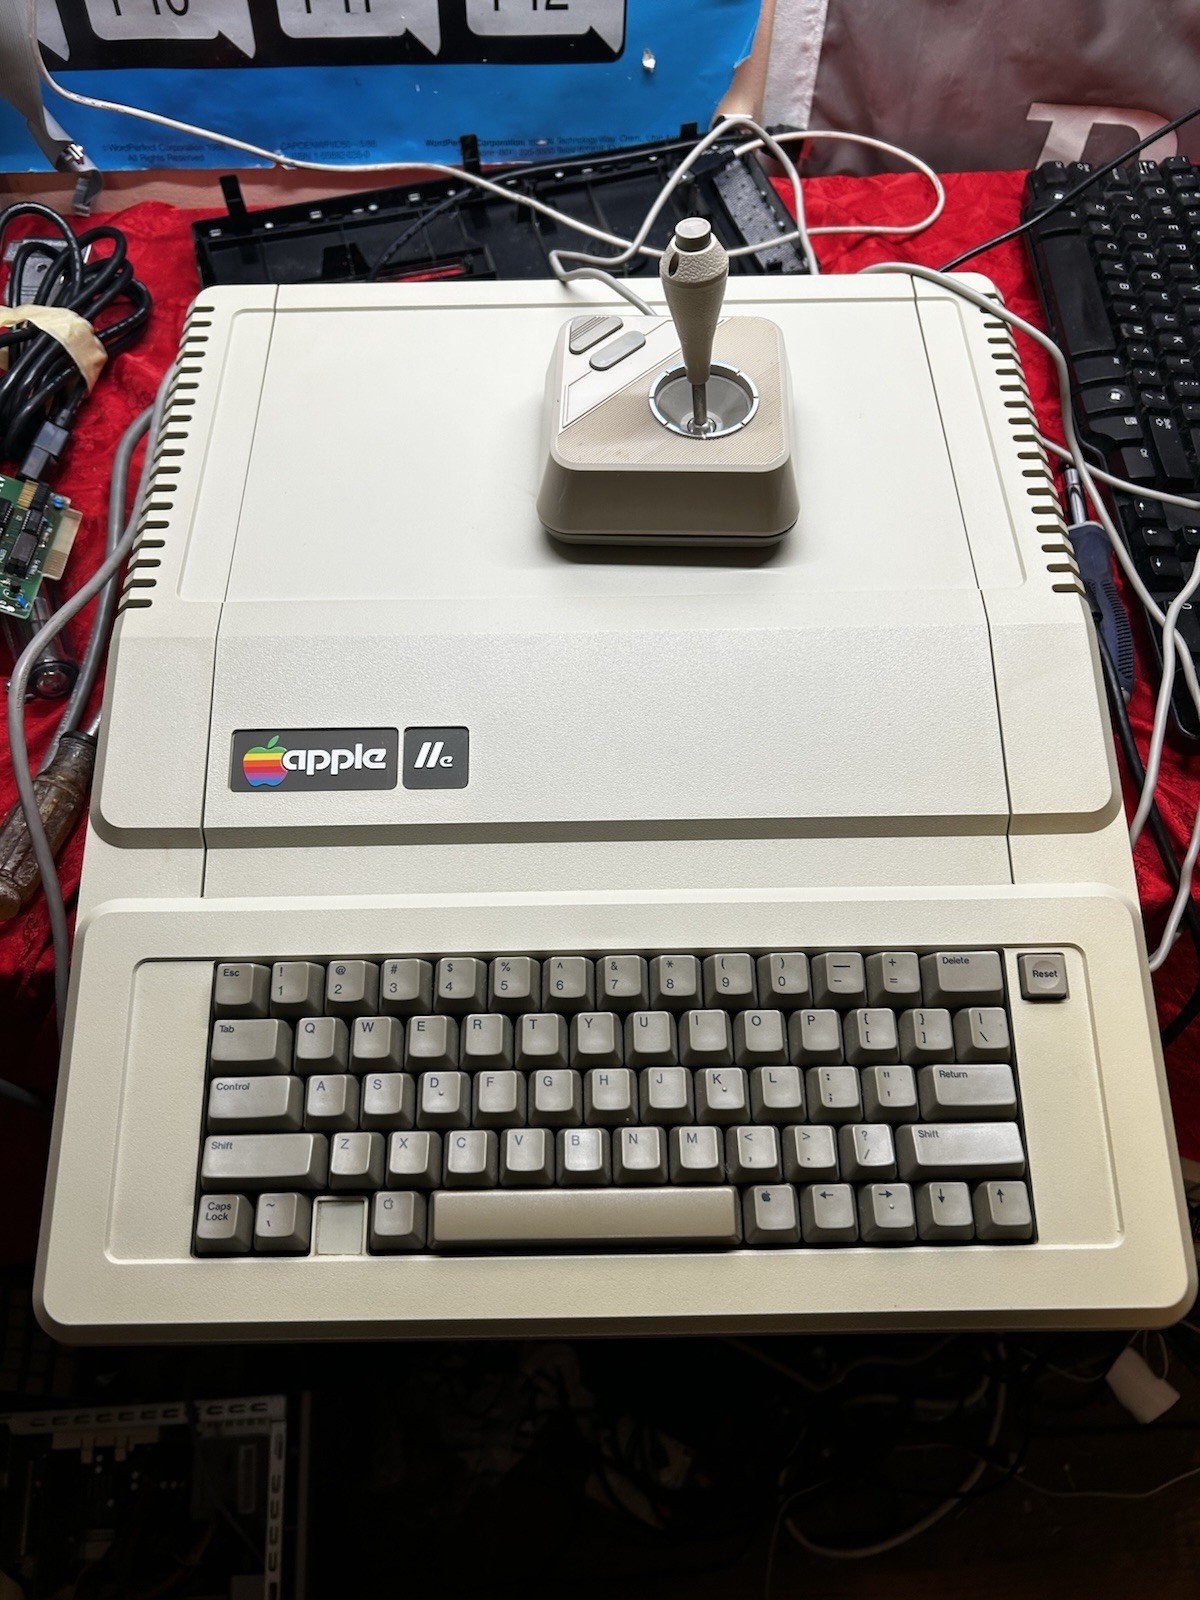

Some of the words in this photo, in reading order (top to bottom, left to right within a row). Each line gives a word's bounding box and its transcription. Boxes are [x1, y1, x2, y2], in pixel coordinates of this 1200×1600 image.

[1137, 232, 1148, 240] D
[1114, 263, 1124, 271] V
[1151, 272, 1161, 280] G
[1173, 336, 1183, 344] K
[282, 743, 387, 776] apple
[1033, 970, 1058, 978] Reset
[445, 981, 453, 992] 4
[500, 979, 509, 991] 5
[555, 979, 564, 991] 6
[611, 978, 619, 990] 7
[666, 978, 675, 990] 8
[721, 976, 730, 988] 9
[777, 975, 787, 987] 0
[333, 983, 343, 995] 2
[389, 982, 398, 994] 3
[416, 1020, 426, 1032] E
[472, 1018, 482, 1030] R
[529, 1018, 538, 1030] T
[584, 1017, 594, 1029] Y
[639, 1016, 649, 1028] U
[751, 1015, 762, 1027] O
[806, 1014, 816, 1026] P
[220, 1025, 234, 1033] Tab
[304, 1022, 316, 1034] Q
[361, 1021, 375, 1033] W
[599, 1074, 609, 1086] H
[655, 1072, 664, 1085] J
[712, 1073, 722, 1085] K
[768, 1072, 778, 1084] L
[939, 1070, 968, 1078] Return
[216, 1082, 250, 1091] Control
[315, 1080, 326, 1092] A
[372, 1078, 383, 1091] S
[429, 1076, 440, 1089] D
[486, 1076, 495, 1088] F
[542, 1075, 553, 1088] G
[513, 1134, 524, 1146] V
[628, 1132, 639, 1145] N
[686, 1132, 698, 1144] M
[918, 1130, 939, 1138] Shift
[211, 1141, 233, 1149] Shift
[340, 1138, 350, 1150] Z
[398, 1137, 409, 1150] X
[455, 1136, 467, 1149] C
[570, 1134, 581, 1147] B
[208, 1202, 231, 1212] Caps
[205, 1212, 228, 1221] Lock
